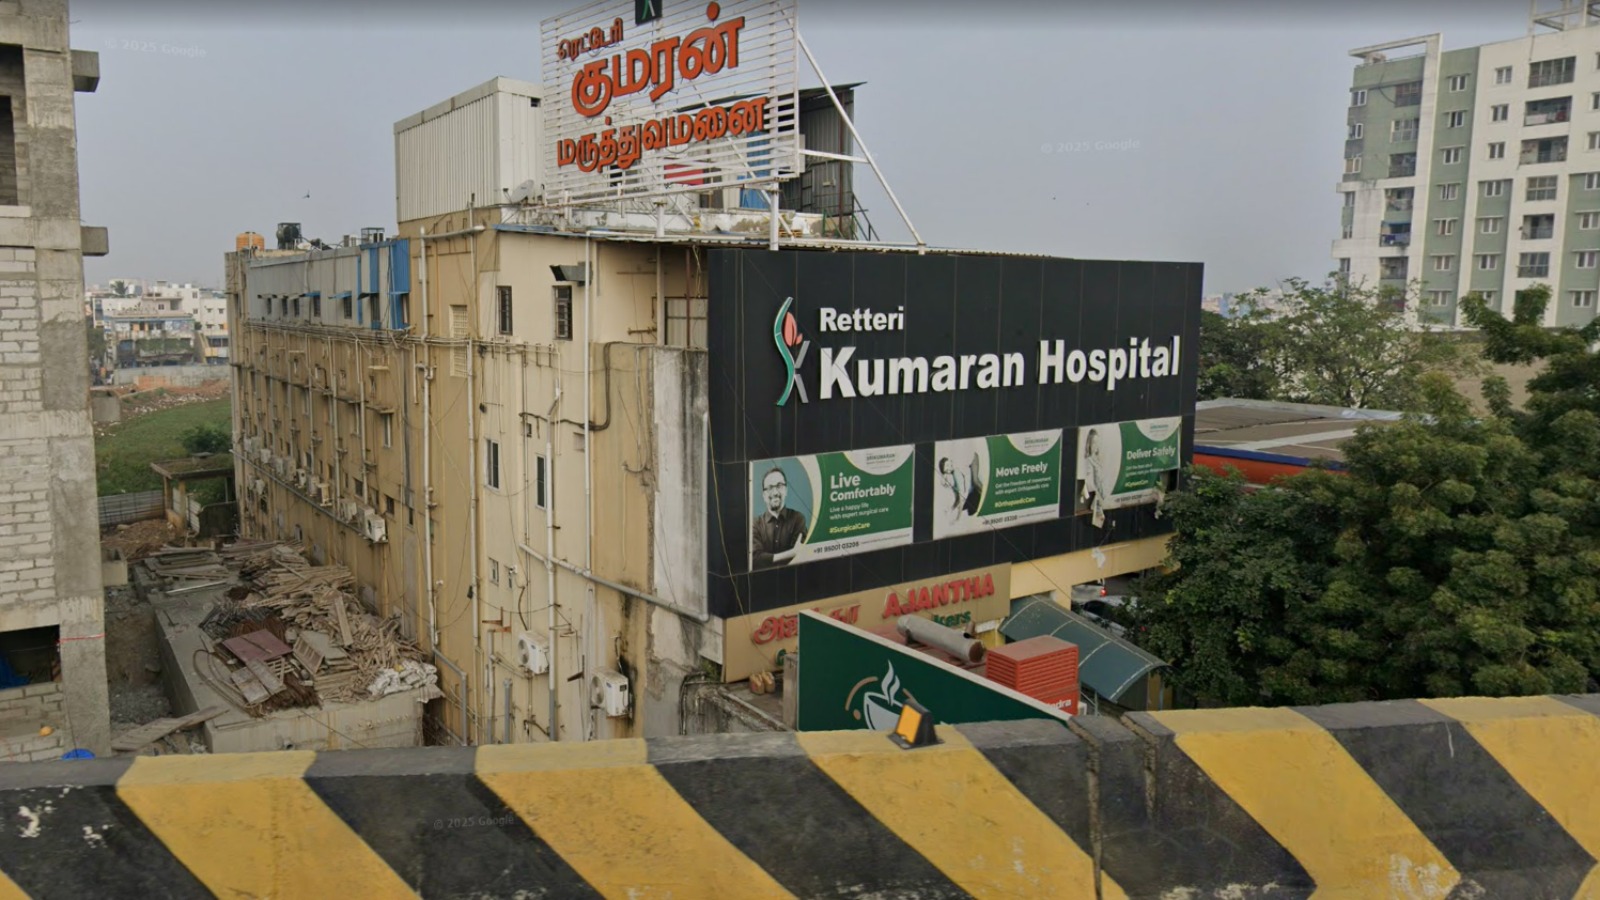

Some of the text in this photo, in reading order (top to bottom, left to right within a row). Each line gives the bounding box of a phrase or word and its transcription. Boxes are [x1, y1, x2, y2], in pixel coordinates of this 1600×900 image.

[571, 2, 746, 117] குமரன்
[557, 96, 769, 173] மருத்துவமனை
[819, 306, 905, 332] Retteri
[819, 335, 1181, 400] Kumaran Hospital
[1126, 445, 1176, 460] Deliver Safely
[995, 461, 1048, 478] Move Freely
[830, 472, 861, 490] Live
[830, 483, 896, 502] Comfortably
[842, 511, 858, 519] expert
[829, 522, 871, 534] #SurgicalCare
[881, 573, 995, 619] AJANTHA
